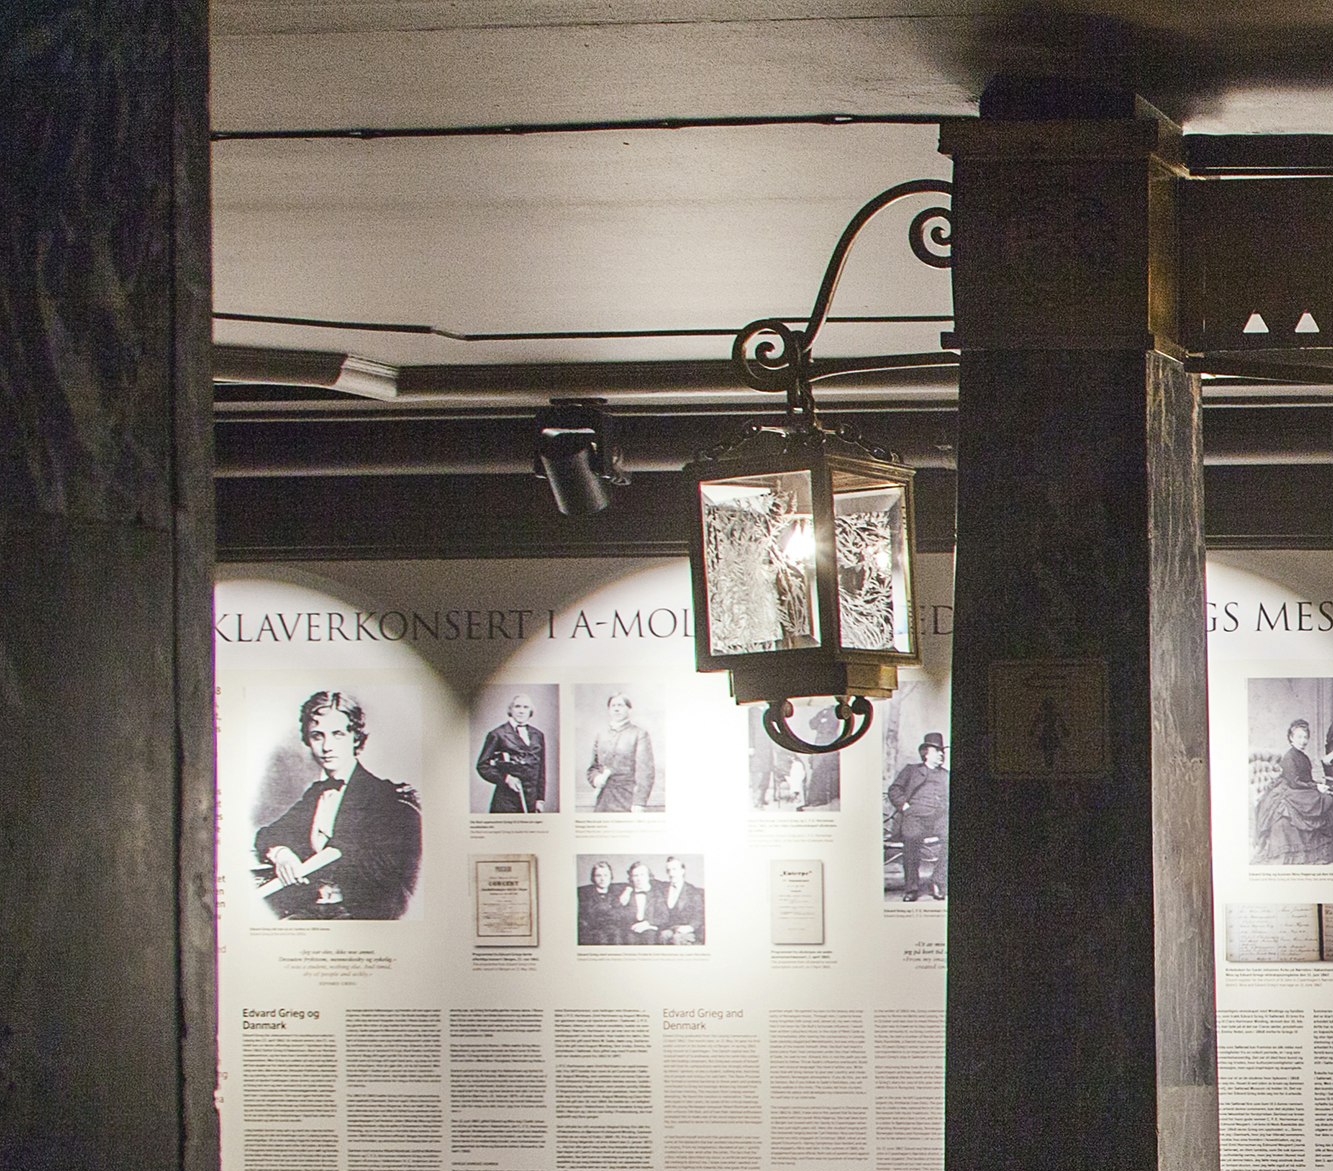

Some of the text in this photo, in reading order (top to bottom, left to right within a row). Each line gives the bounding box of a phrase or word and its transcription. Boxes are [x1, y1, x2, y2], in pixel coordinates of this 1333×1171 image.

[214, 607, 695, 643] KLAVERKONSERT I A-MOL
[242, 1008, 320, 1020] Edvard Grieg og
[663, 1008, 744, 1020] Edvard Grieg and
[242, 1020, 287, 1030] Danmark
[663, 1020, 707, 1030] Denmark
